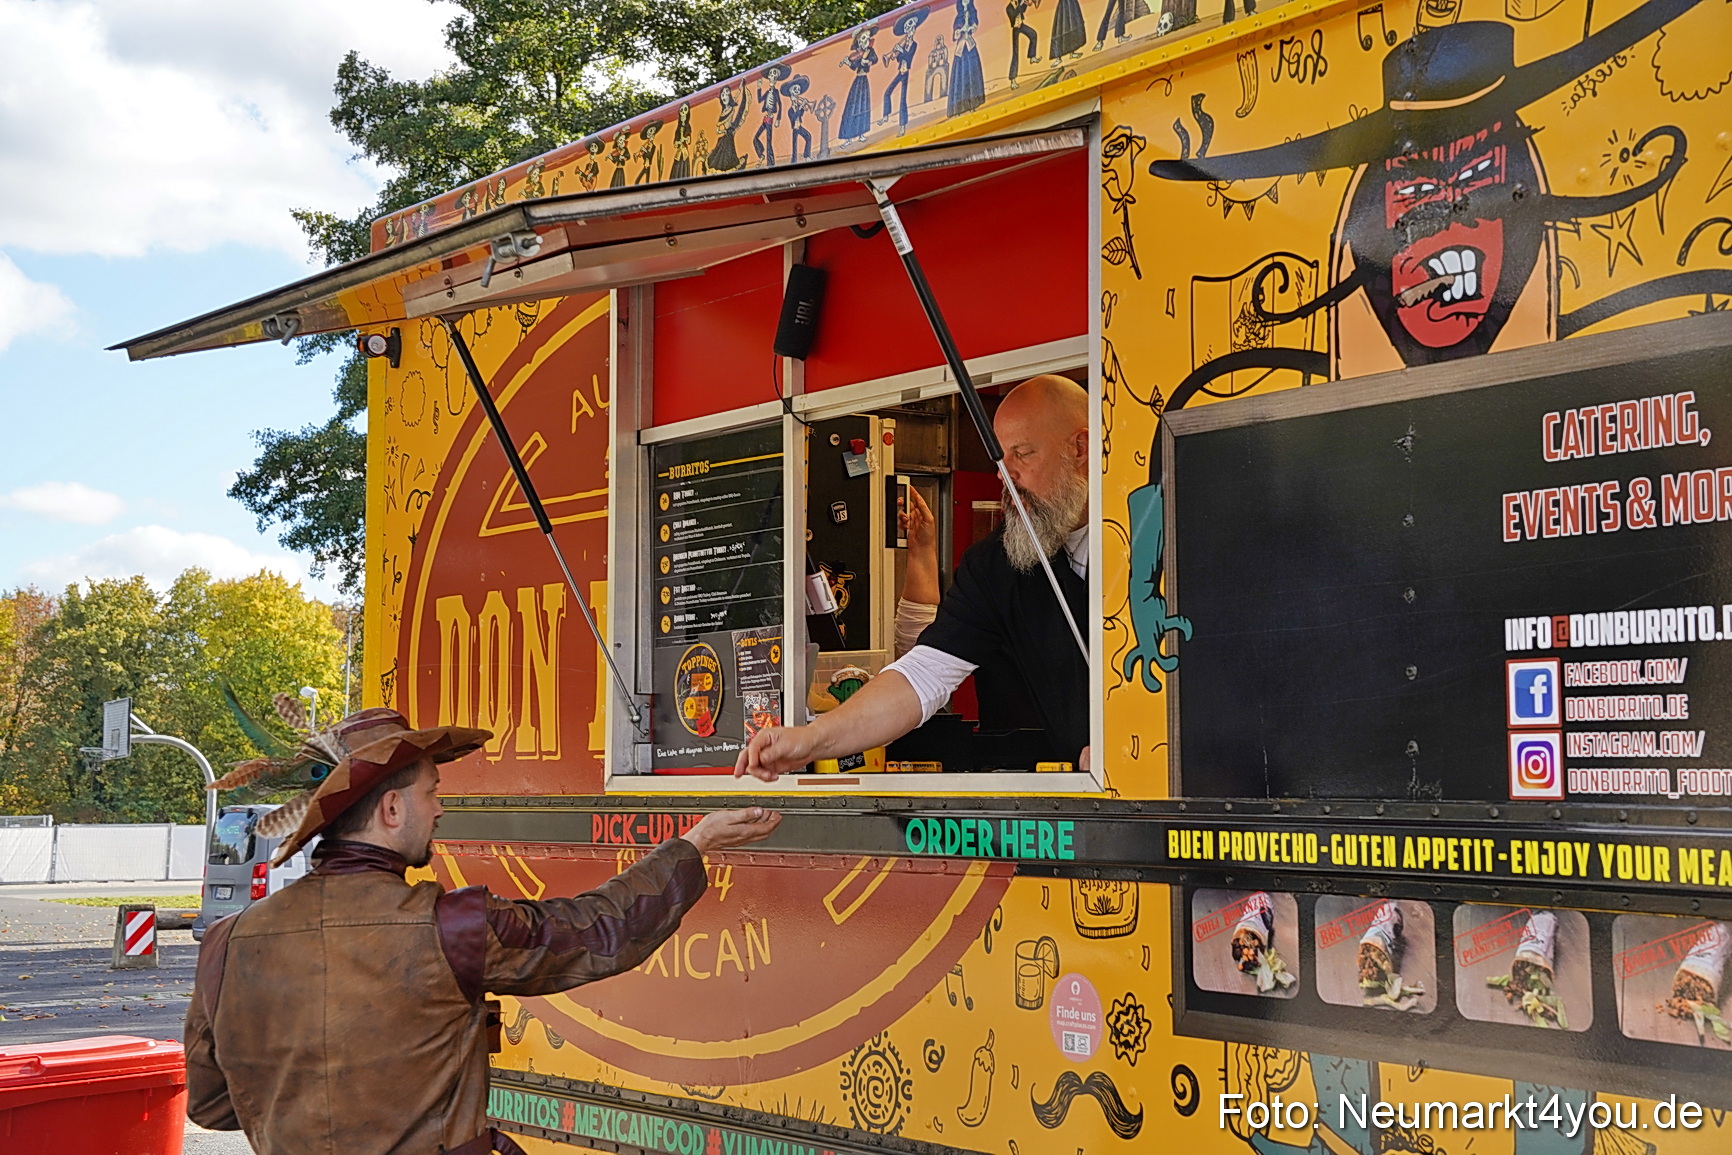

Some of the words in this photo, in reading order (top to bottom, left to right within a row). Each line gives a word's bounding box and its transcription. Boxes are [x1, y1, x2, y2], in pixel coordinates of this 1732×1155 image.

[1542, 391, 1712, 462] CATERING,
[669, 460, 710, 479] BURRITOS
[1502, 481, 1622, 542] EVENTS
[1626, 476, 1657, 530] &
[436, 582, 567, 762] DON
[682, 655, 718, 675] TOPPINGS
[1563, 657, 1688, 687] FACEBOOK.COM/
[1565, 694, 1689, 722] DONBURRITO.DE
[1566, 730, 1705, 757] INSTAGRAM.COM/
[592, 814, 675, 845] PICK-UP
[905, 817, 995, 858] ORDER
[1000, 820, 1075, 860] HERE
[1168, 829, 1214, 860] BUEN
[1597, 843, 1671, 883] YOUR
[634, 917, 771, 979] XICAN
[1320, 923, 1343, 945] BBQ
[1056, 1005, 1080, 1020] Finde
[1081, 1010, 1097, 1022] uns
[562, 1101, 705, 1155] #MEXICANFOOD
